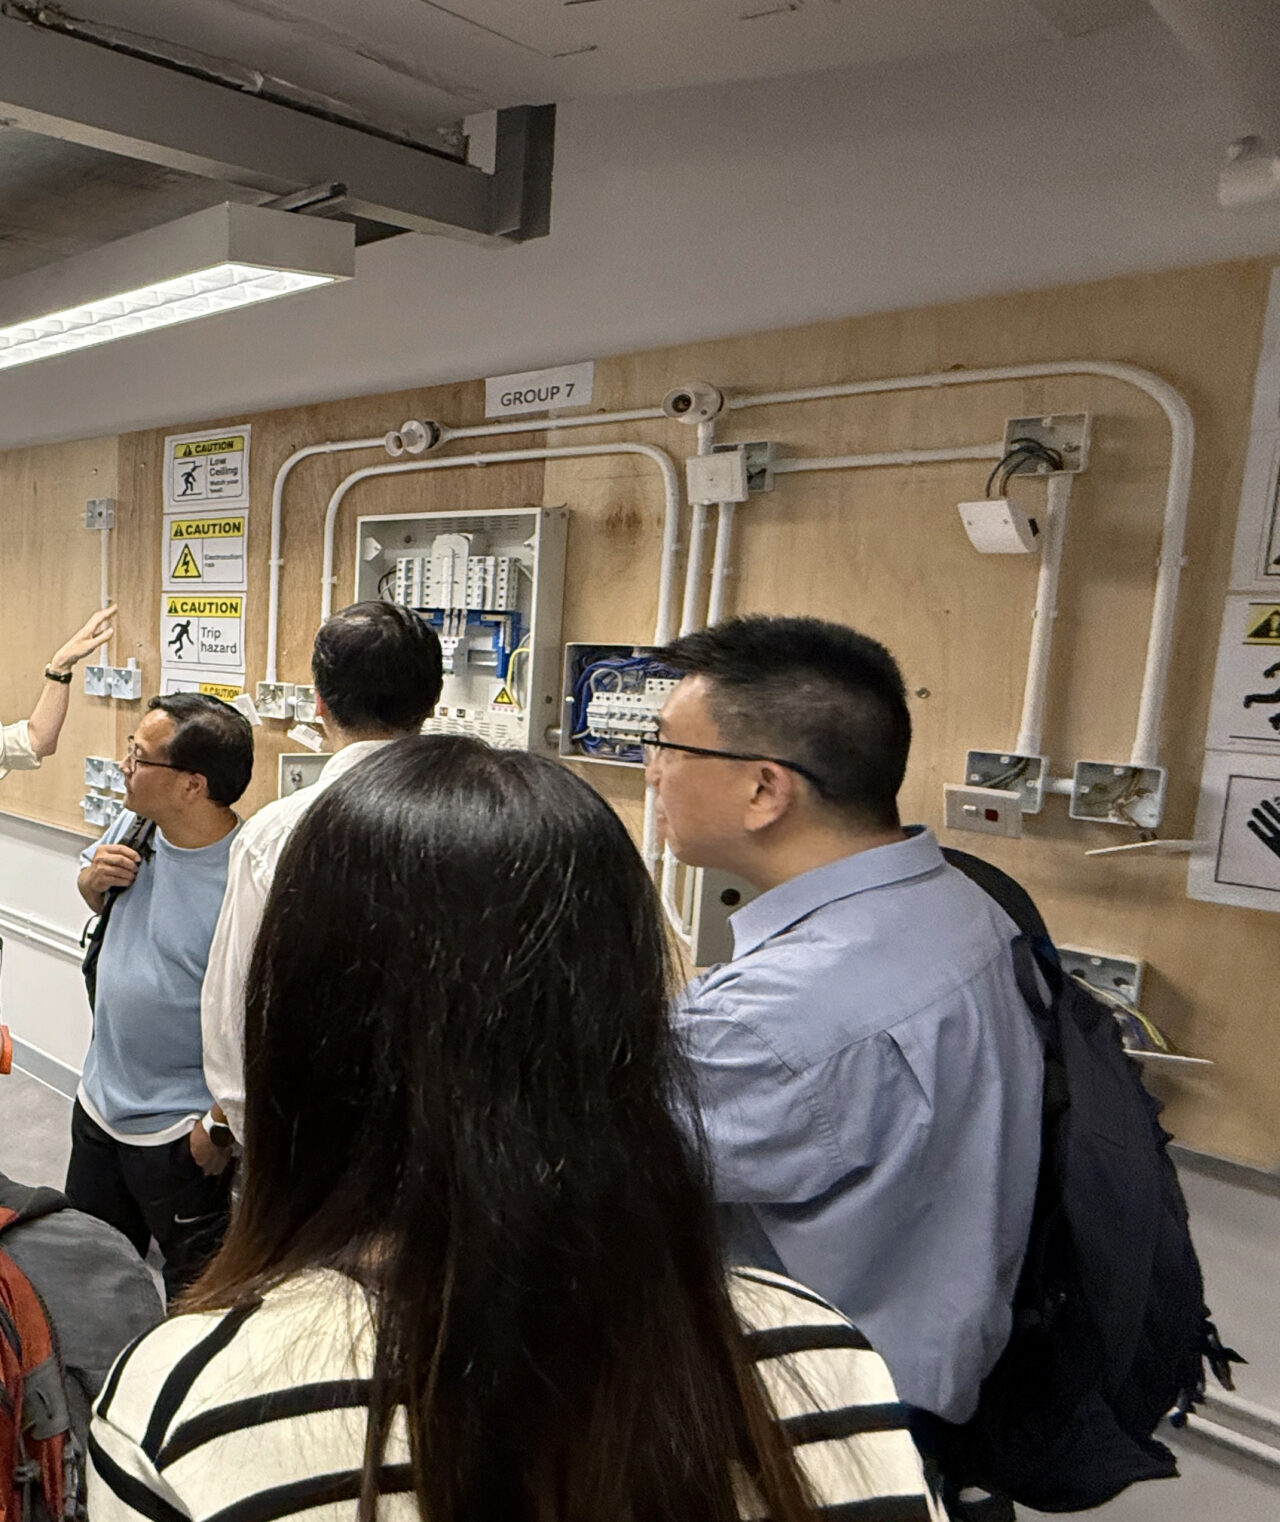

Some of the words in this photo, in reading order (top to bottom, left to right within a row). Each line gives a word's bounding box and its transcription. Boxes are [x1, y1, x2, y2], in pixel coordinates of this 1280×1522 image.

[501, 385, 560, 407] GROUP
[565, 383, 576, 398] 7
[195, 440, 234, 453] CAUTION
[209, 457, 227, 467] Low
[209, 466, 239, 478] Ceiling
[185, 521, 242, 536] CAUTION
[181, 601, 239, 614] CAUTION
[200, 626, 222, 643] Trip
[200, 641, 237, 655] hazard
